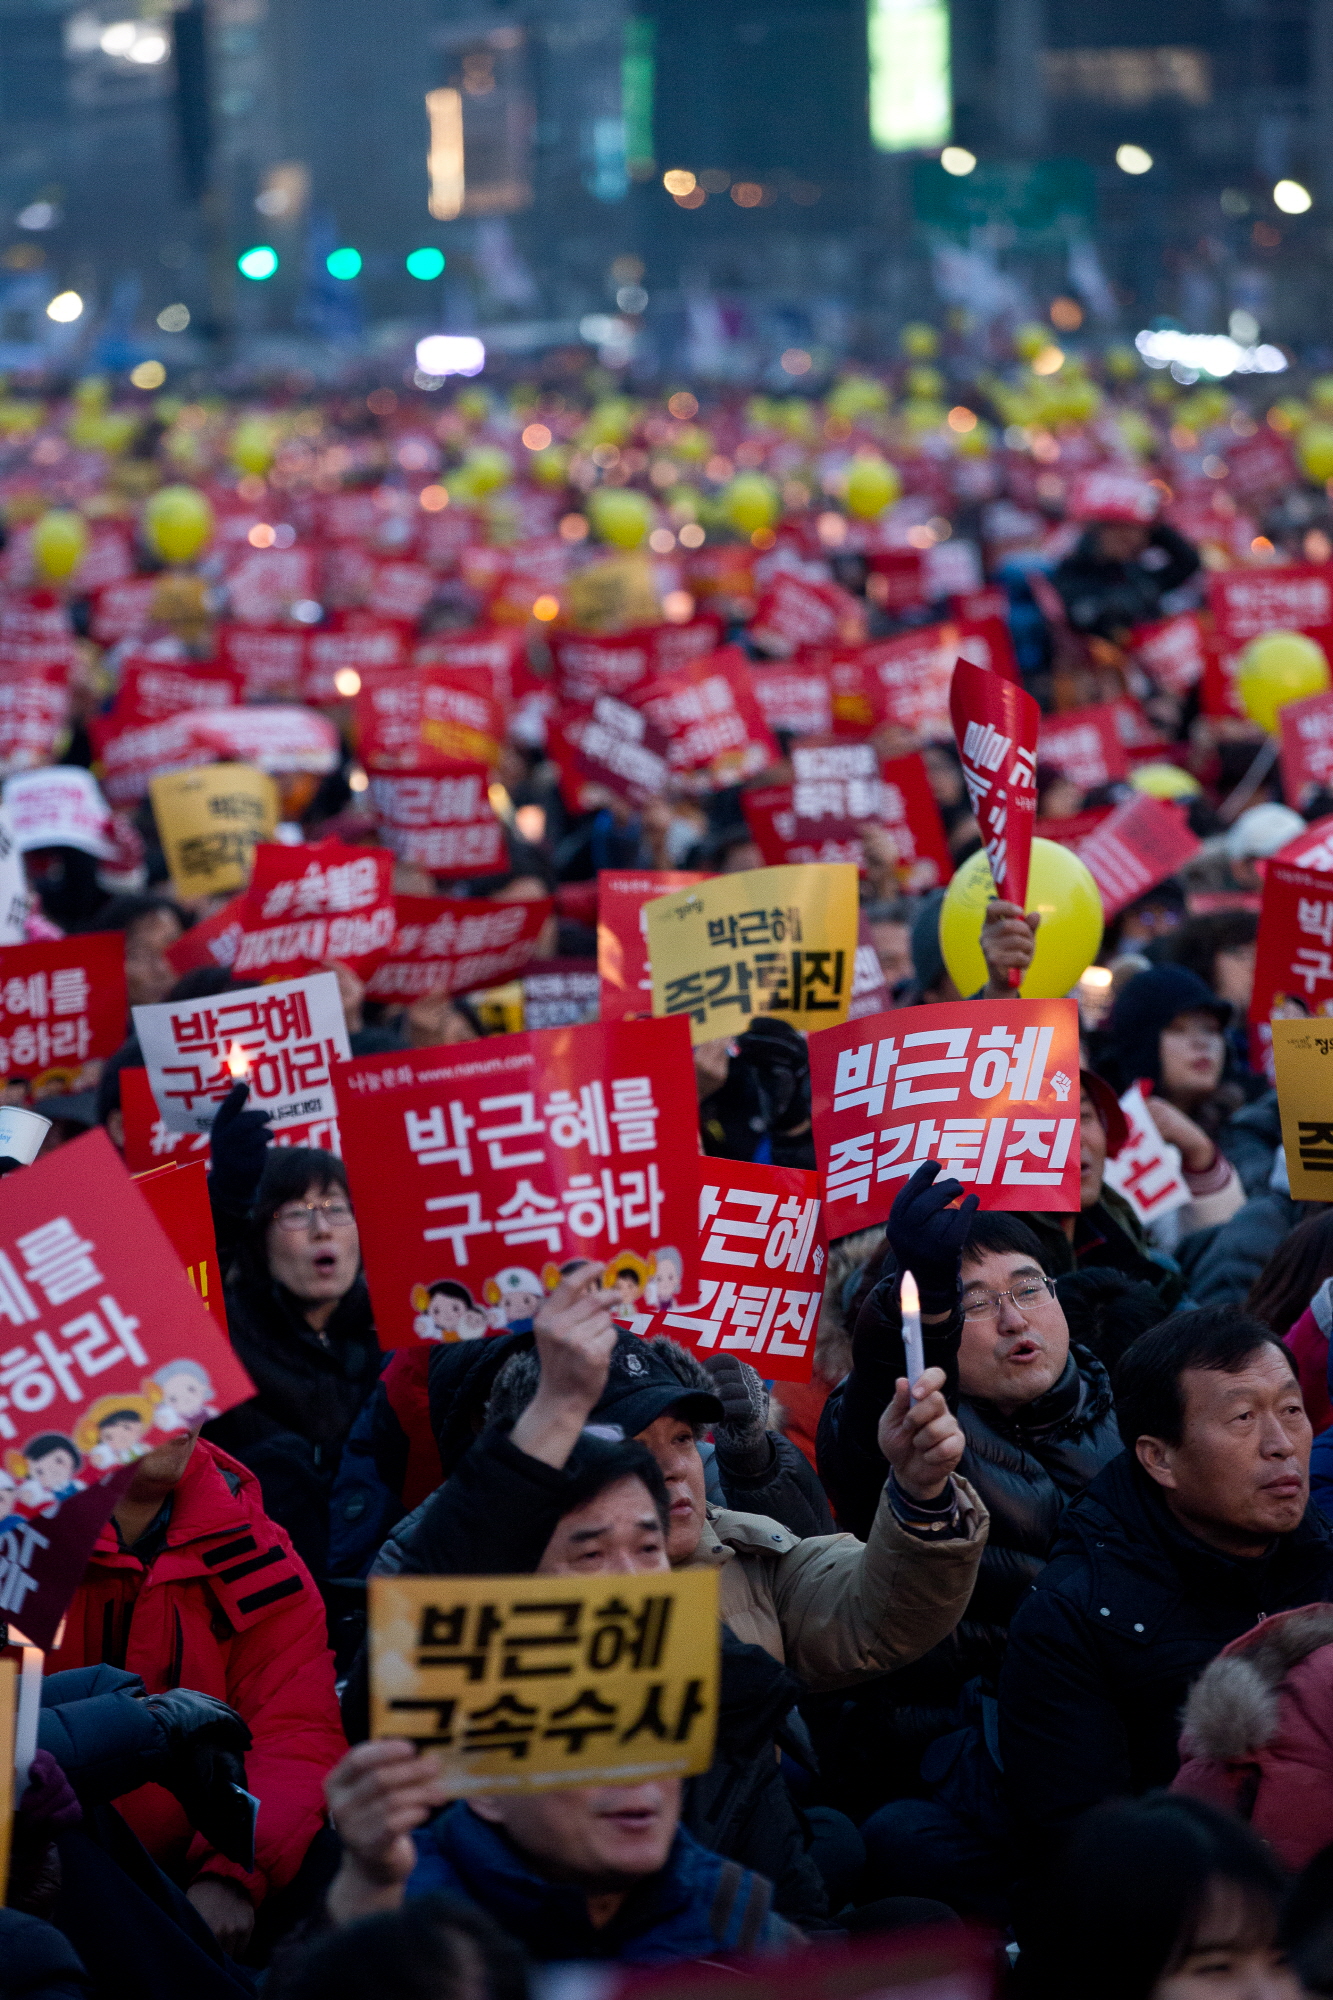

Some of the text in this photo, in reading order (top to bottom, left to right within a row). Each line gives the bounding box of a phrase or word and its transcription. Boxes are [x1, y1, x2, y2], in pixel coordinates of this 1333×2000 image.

[706, 906, 803, 949] 박근혜
[0, 967, 92, 1019] 혜를
[170, 990, 313, 1057] 박근혜
[665, 950, 845, 1024] 즉각퇴진
[0, 1015, 93, 1073] 하라
[833, 1026, 1055, 1117] 박근혜
[404, 1076, 660, 1177] 박근혜를
[826, 1118, 1077, 1204] 즉각퇴진
[423, 1162, 665, 1268] 구속하라
[699, 1184, 820, 1275] 근혜
[612, 1278, 822, 1358] 각퇴진
[418, 1595, 674, 1684] 박근혜
[381, 1679, 706, 1759] 구속수사
